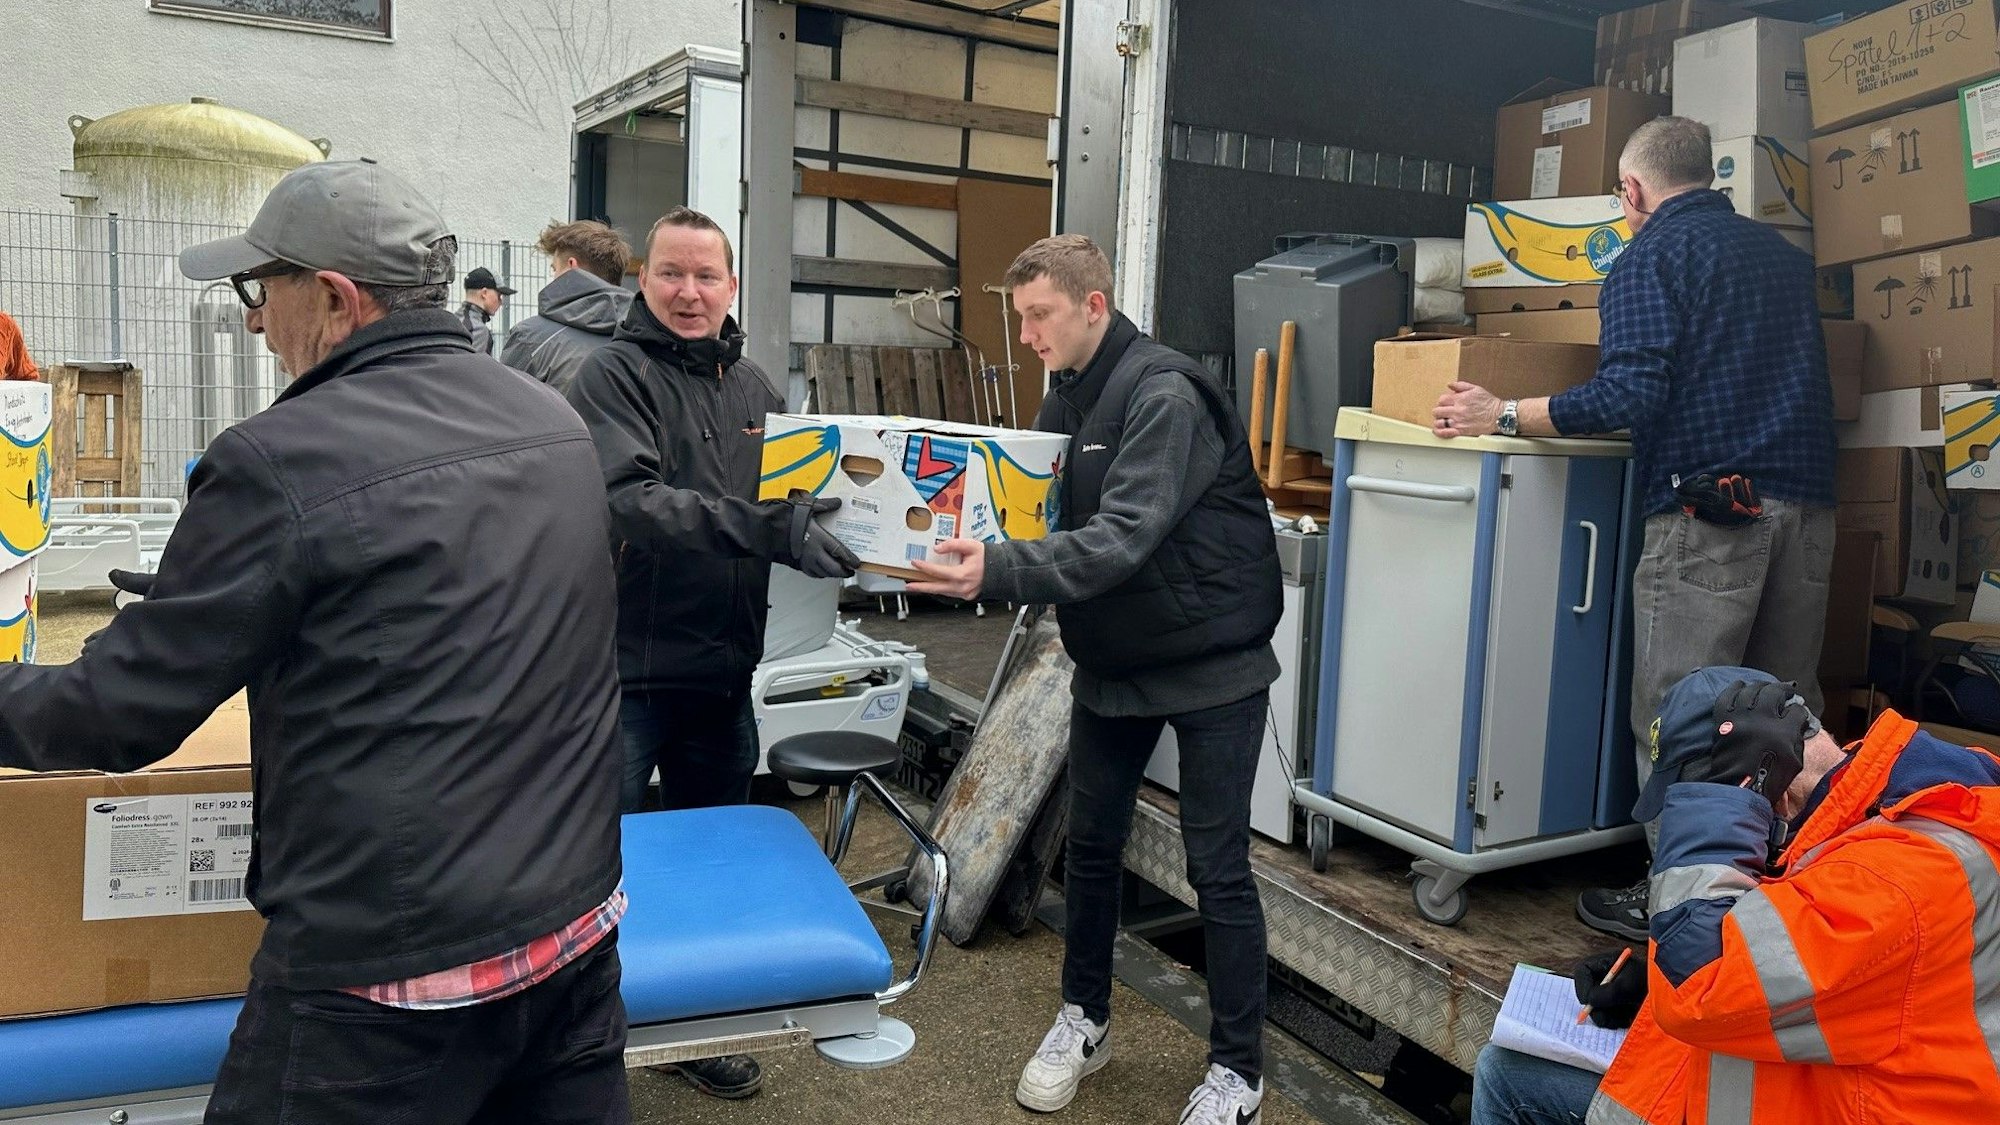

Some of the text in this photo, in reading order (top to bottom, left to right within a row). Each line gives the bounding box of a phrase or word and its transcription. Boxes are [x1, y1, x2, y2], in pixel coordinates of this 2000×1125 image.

[1822, 29, 1903, 84] Spatel
[1857, 67, 1919, 94] MADE IN TAIWAN
[1592, 245, 1624, 270] Chiquita
[195, 800, 253, 810] REF 992 92
[111, 814, 150, 823] Foliodress
